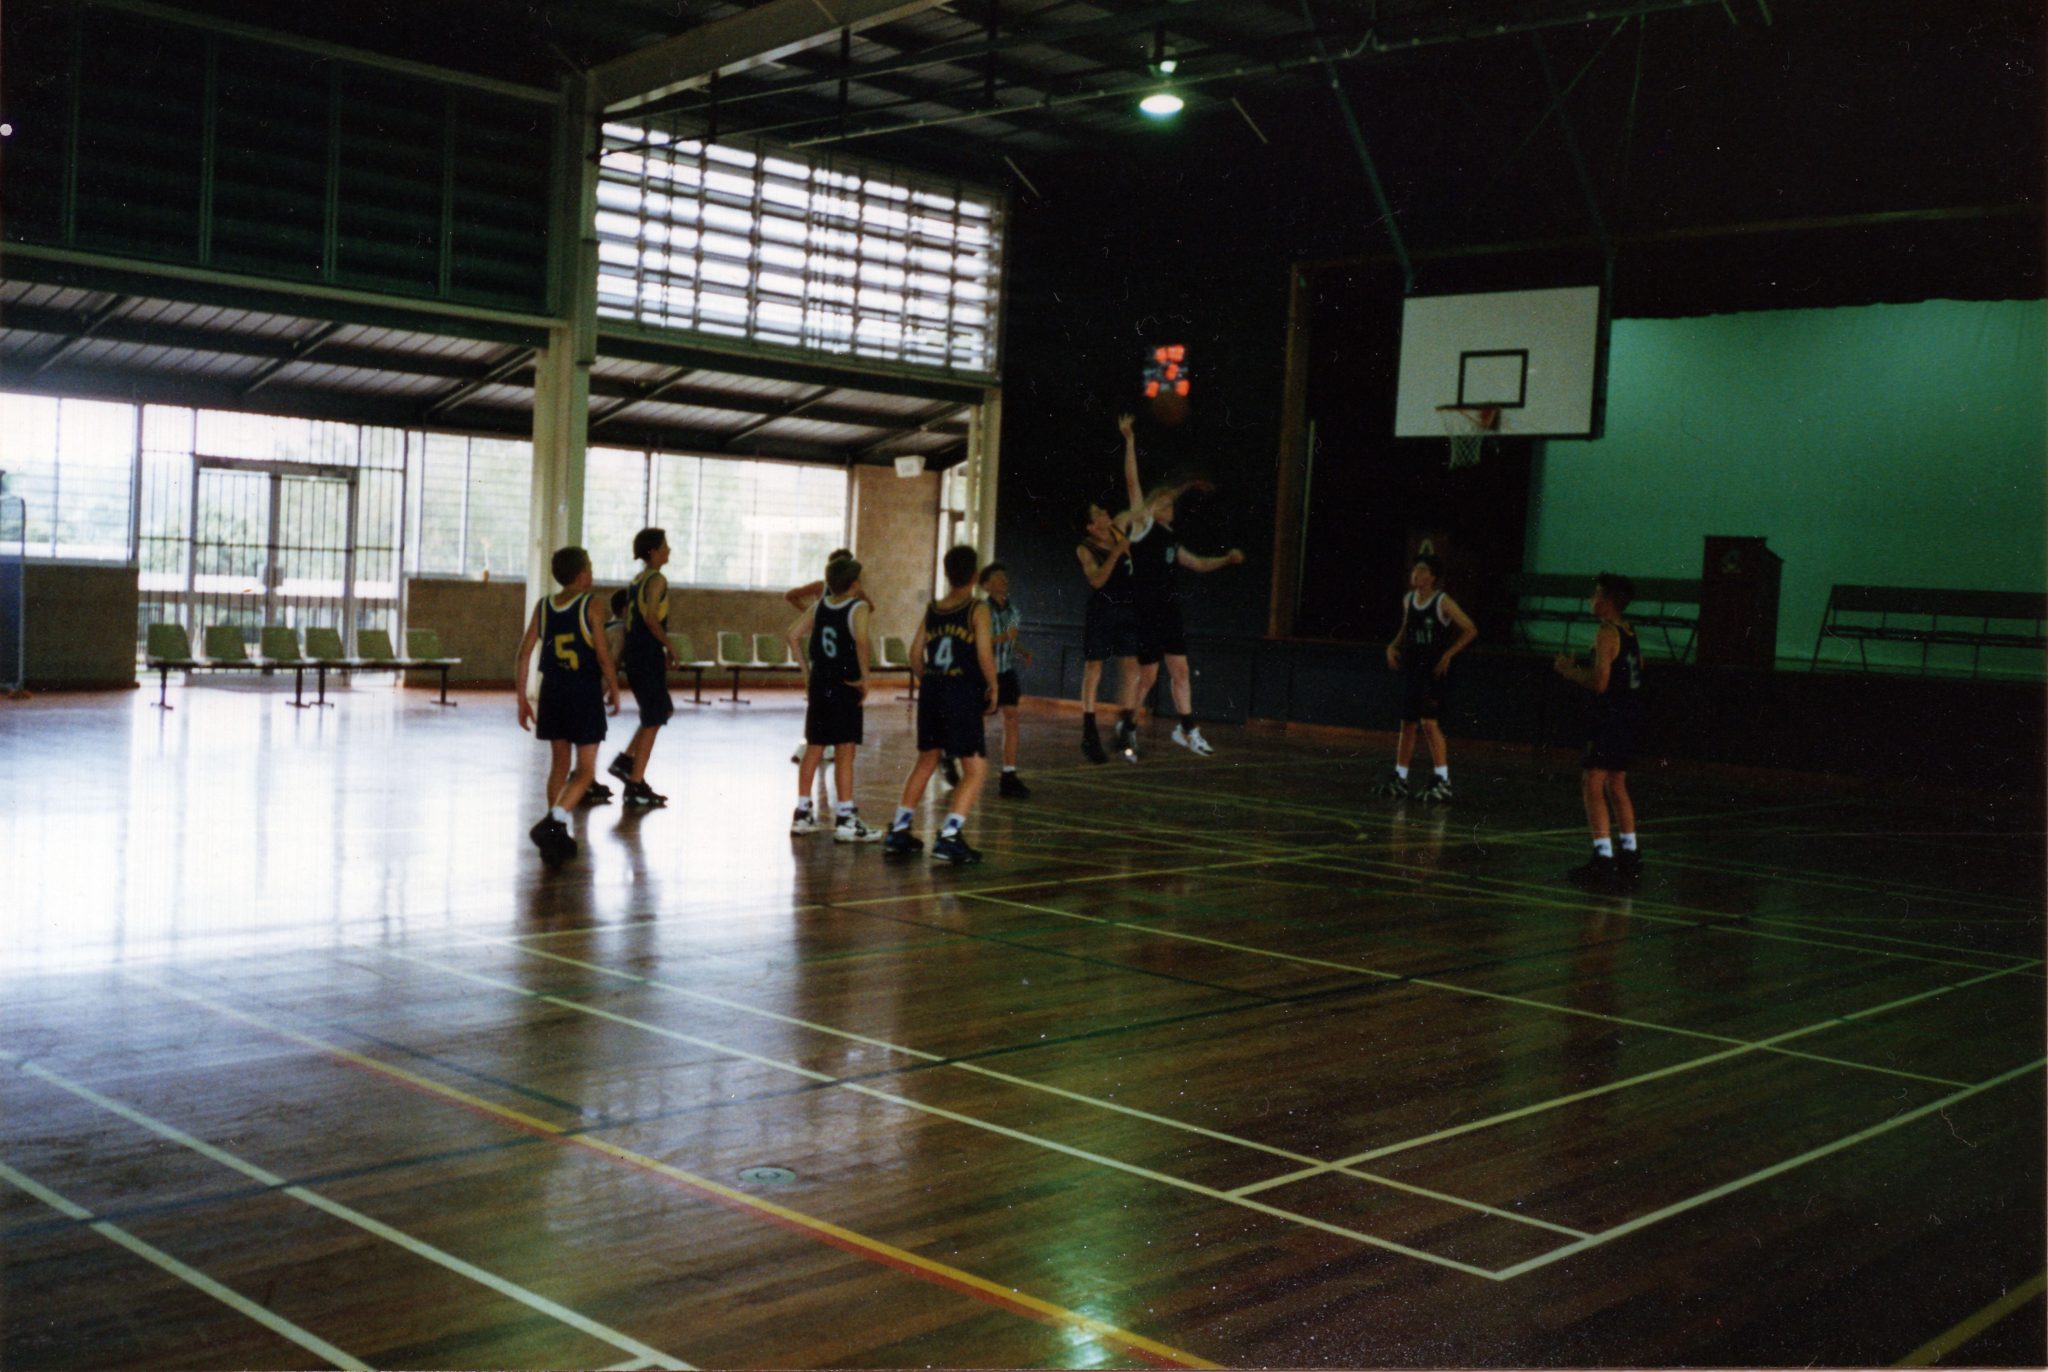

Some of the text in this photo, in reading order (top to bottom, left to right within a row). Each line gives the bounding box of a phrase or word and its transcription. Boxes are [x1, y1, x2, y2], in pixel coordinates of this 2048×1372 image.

[553, 632, 580, 672] 5
[820, 625, 840, 659] 6
[933, 635, 955, 674] 4
